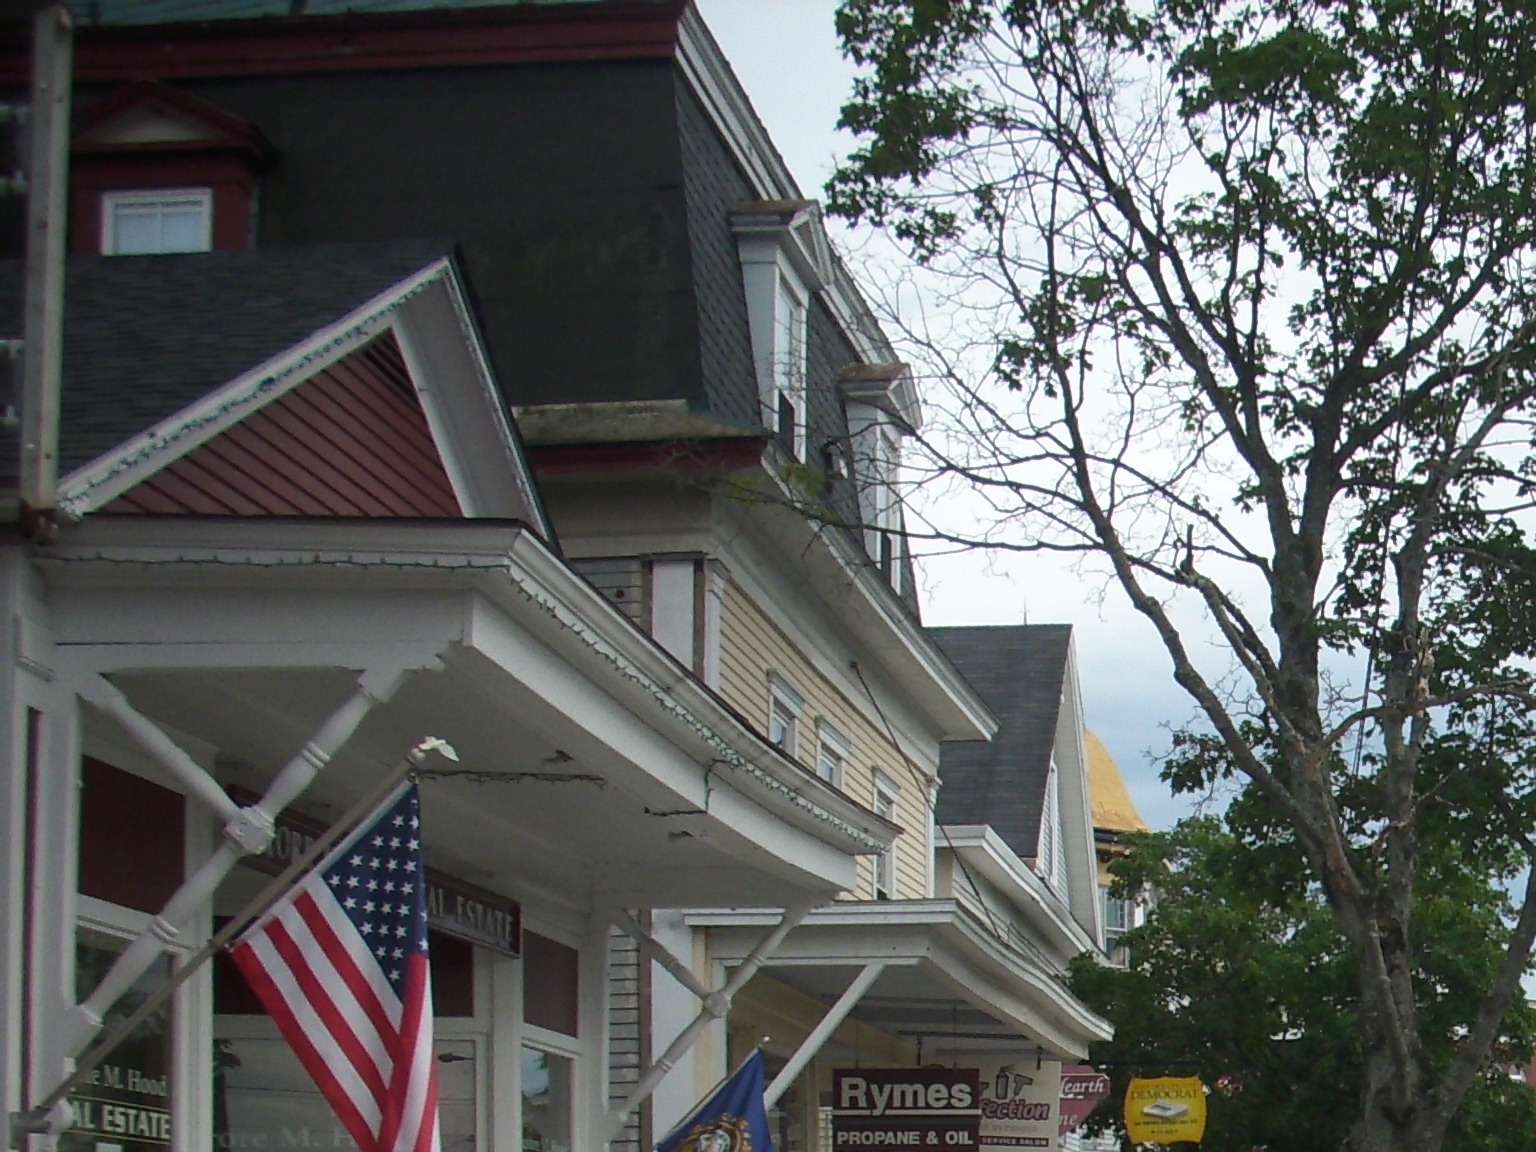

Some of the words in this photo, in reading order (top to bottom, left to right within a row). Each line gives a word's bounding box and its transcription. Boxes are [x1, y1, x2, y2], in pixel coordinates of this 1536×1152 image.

[428, 885, 444, 917] AL
[456, 896, 513, 942] ESTATE
[841, 1077, 973, 1116] Rymes
[1131, 1088, 1197, 1100] DEMOCRAT
[102, 1105, 172, 1139] ESTATE
[981, 1098, 1050, 1120] fection
[837, 1131, 921, 1145] PROPANE
[925, 1131, 938, 1145] &
[945, 1131, 973, 1145] OIL
